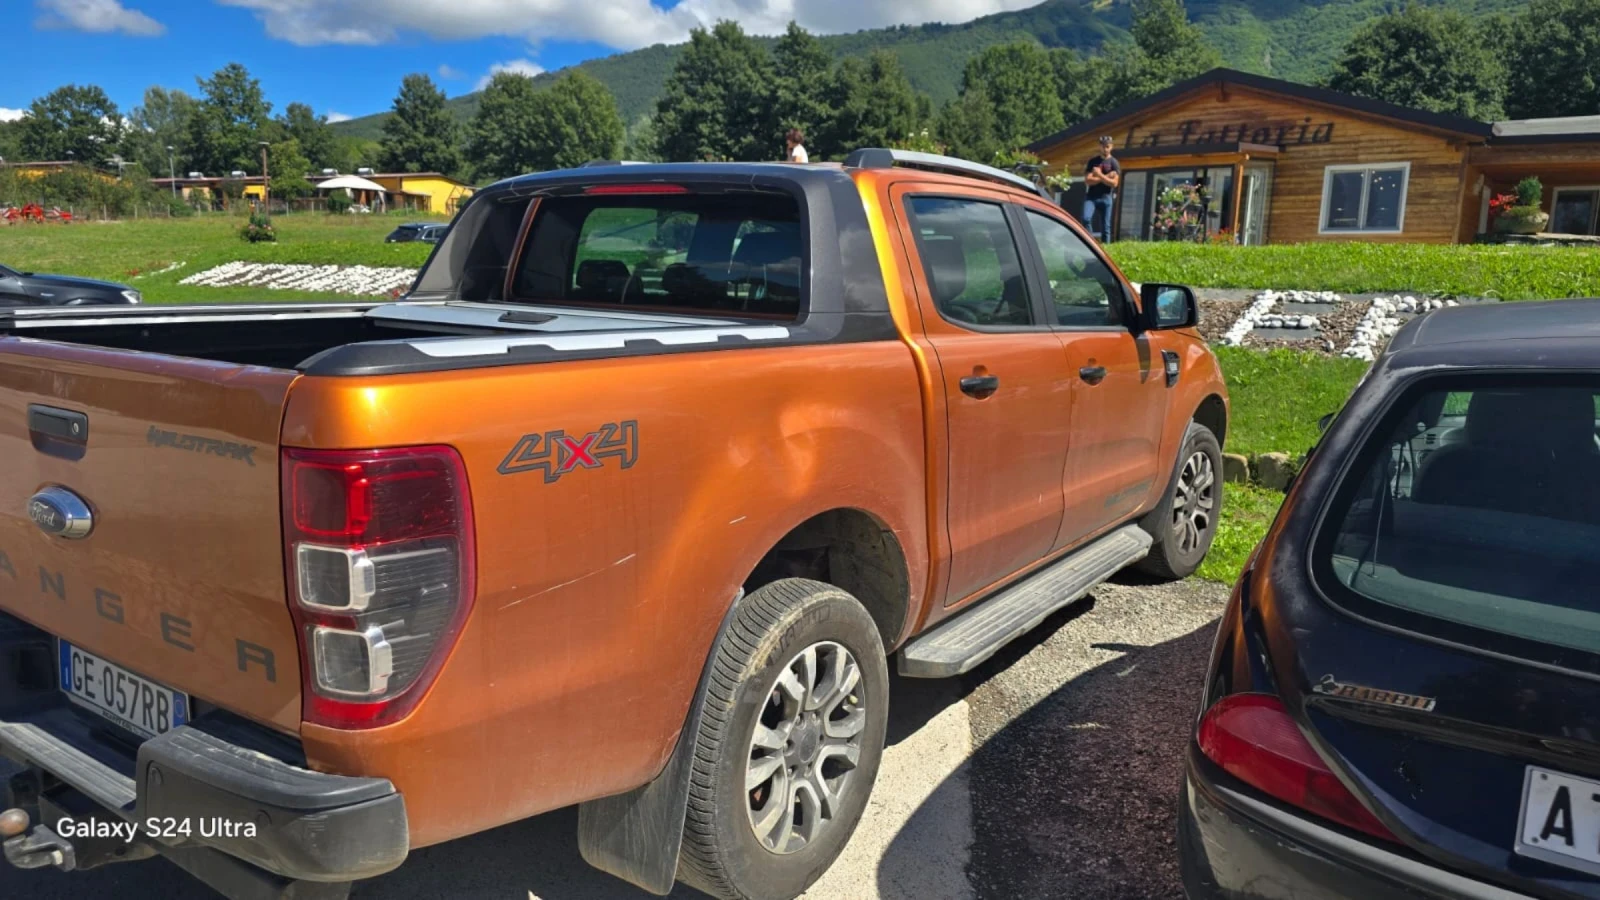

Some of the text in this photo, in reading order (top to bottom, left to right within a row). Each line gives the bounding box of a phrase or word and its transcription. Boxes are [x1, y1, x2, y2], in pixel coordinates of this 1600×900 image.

[1123, 116, 1336, 149] La Fattoria
[32, 501, 55, 527] Ford
